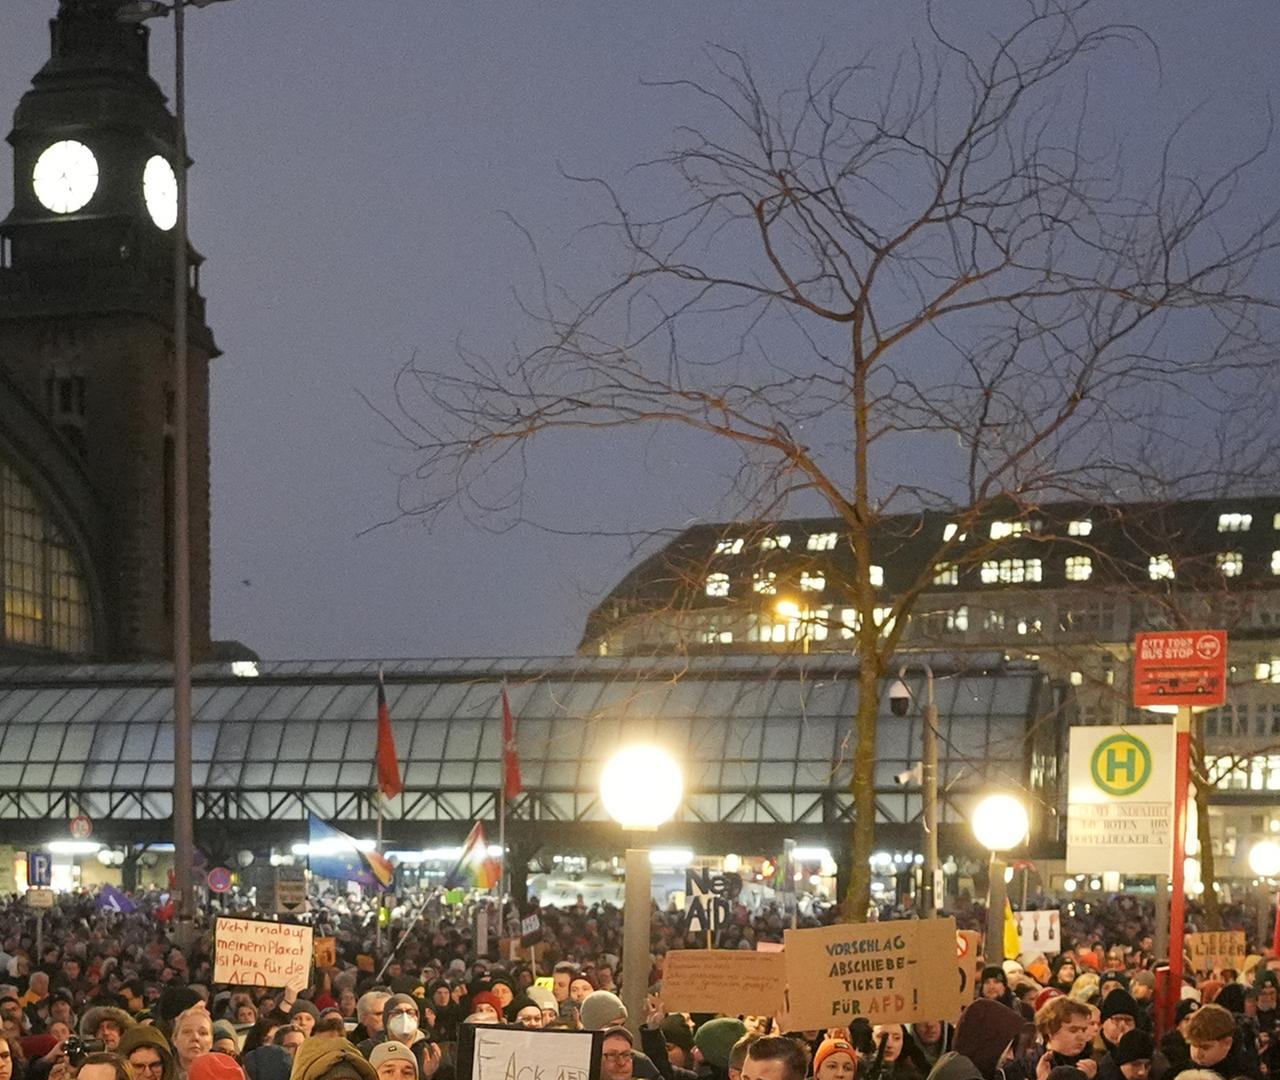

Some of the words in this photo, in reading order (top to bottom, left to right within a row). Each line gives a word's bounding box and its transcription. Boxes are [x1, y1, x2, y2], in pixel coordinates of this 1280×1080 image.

[1141, 649, 1163, 660] BUS
[1165, 647, 1194, 659] STOP
[1106, 748, 1136, 782] H
[686, 896, 731, 931] AfD
[218, 920, 250, 933] Nicht
[217, 939, 267, 954] meinem
[825, 935, 906, 957] VORSCHLAG
[284, 958, 305, 976] die
[828, 956, 918, 978] ABSCHIEBE-
[842, 976, 896, 992] TICKET
[831, 999, 861, 1016] FÜR
[867, 994, 906, 1014] AFD
